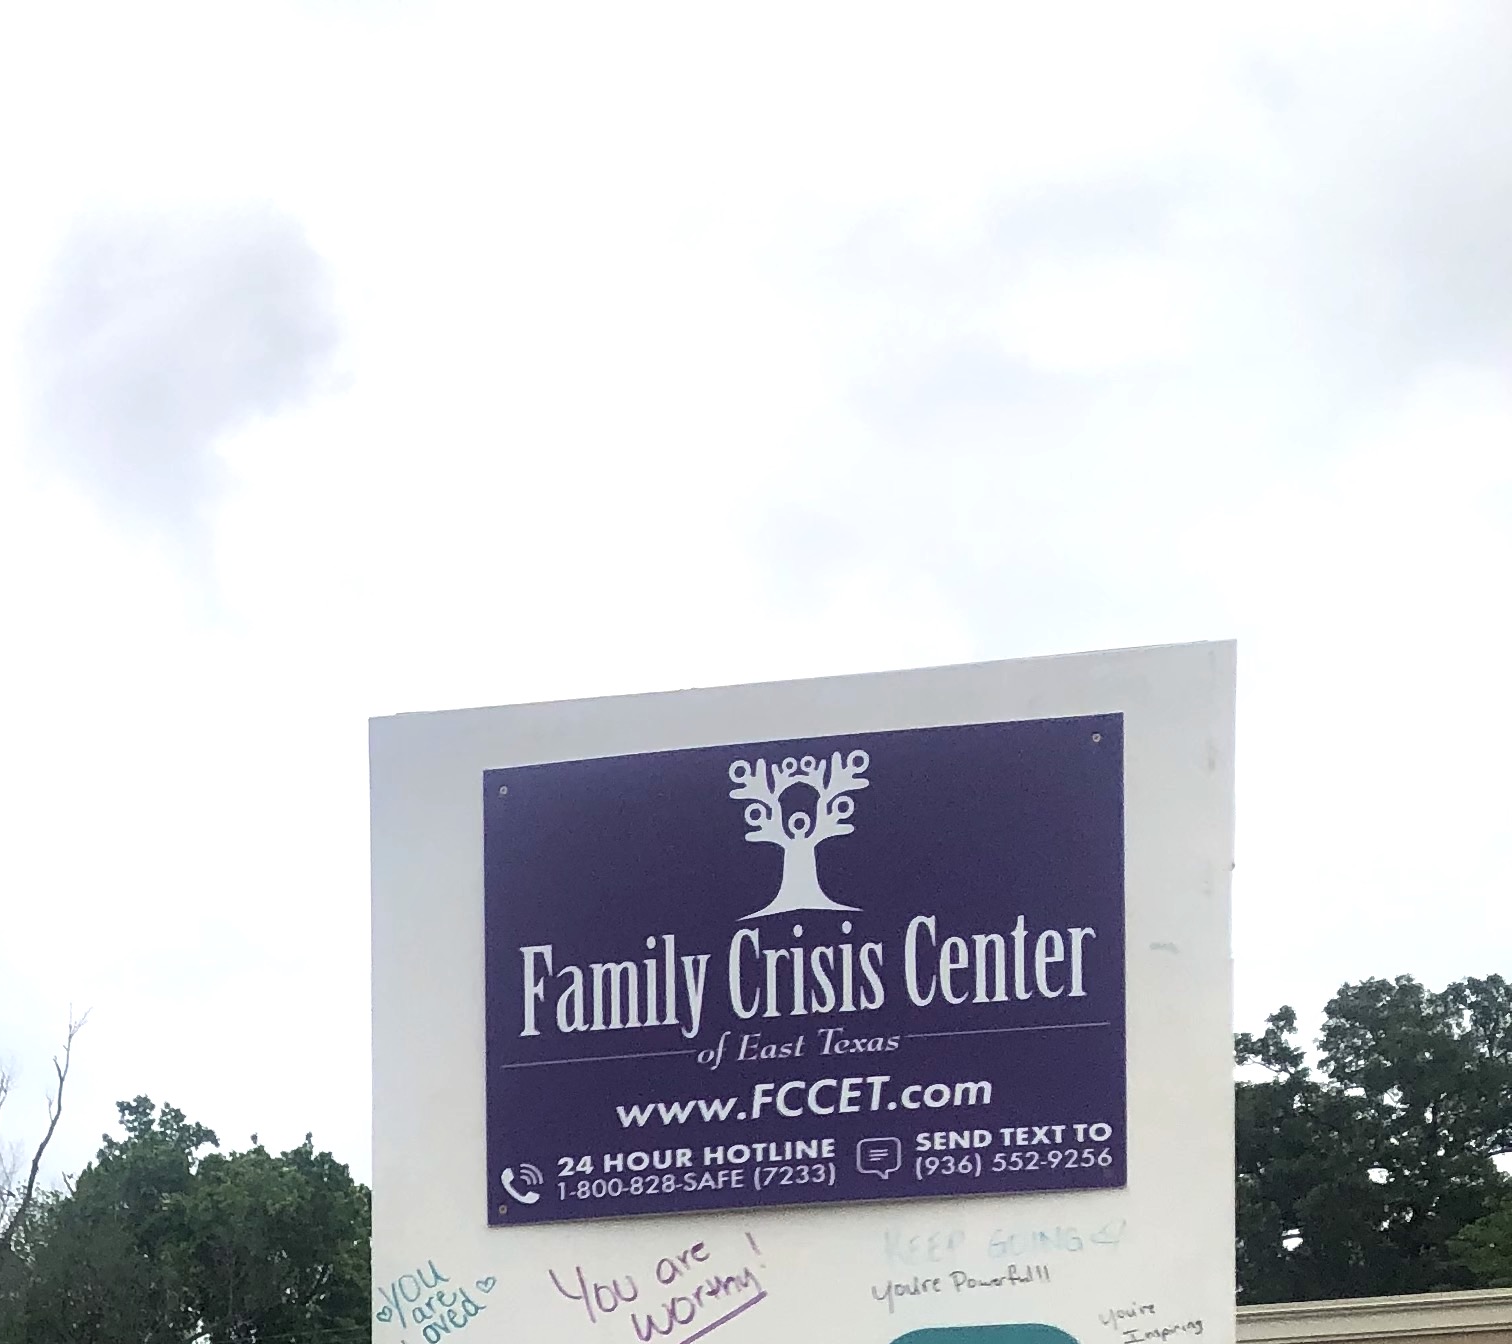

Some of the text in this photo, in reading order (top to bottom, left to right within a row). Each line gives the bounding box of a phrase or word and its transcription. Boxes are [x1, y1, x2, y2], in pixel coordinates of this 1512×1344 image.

[519, 914, 1096, 1038] Family Crisis Center
[698, 1027, 900, 1069] of East Texas
[617, 1075, 992, 1128] www.FCCET.com
[558, 1137, 835, 1176] 24 HOUR HOTLINE
[916, 1122, 1112, 1151] SEND TEXT TO
[558, 1163, 835, 1201] 1-800-828-SAFE (7233)
[915, 1147, 1112, 1181] (936) 552-9256
[549, 1241, 710, 1323] You are
